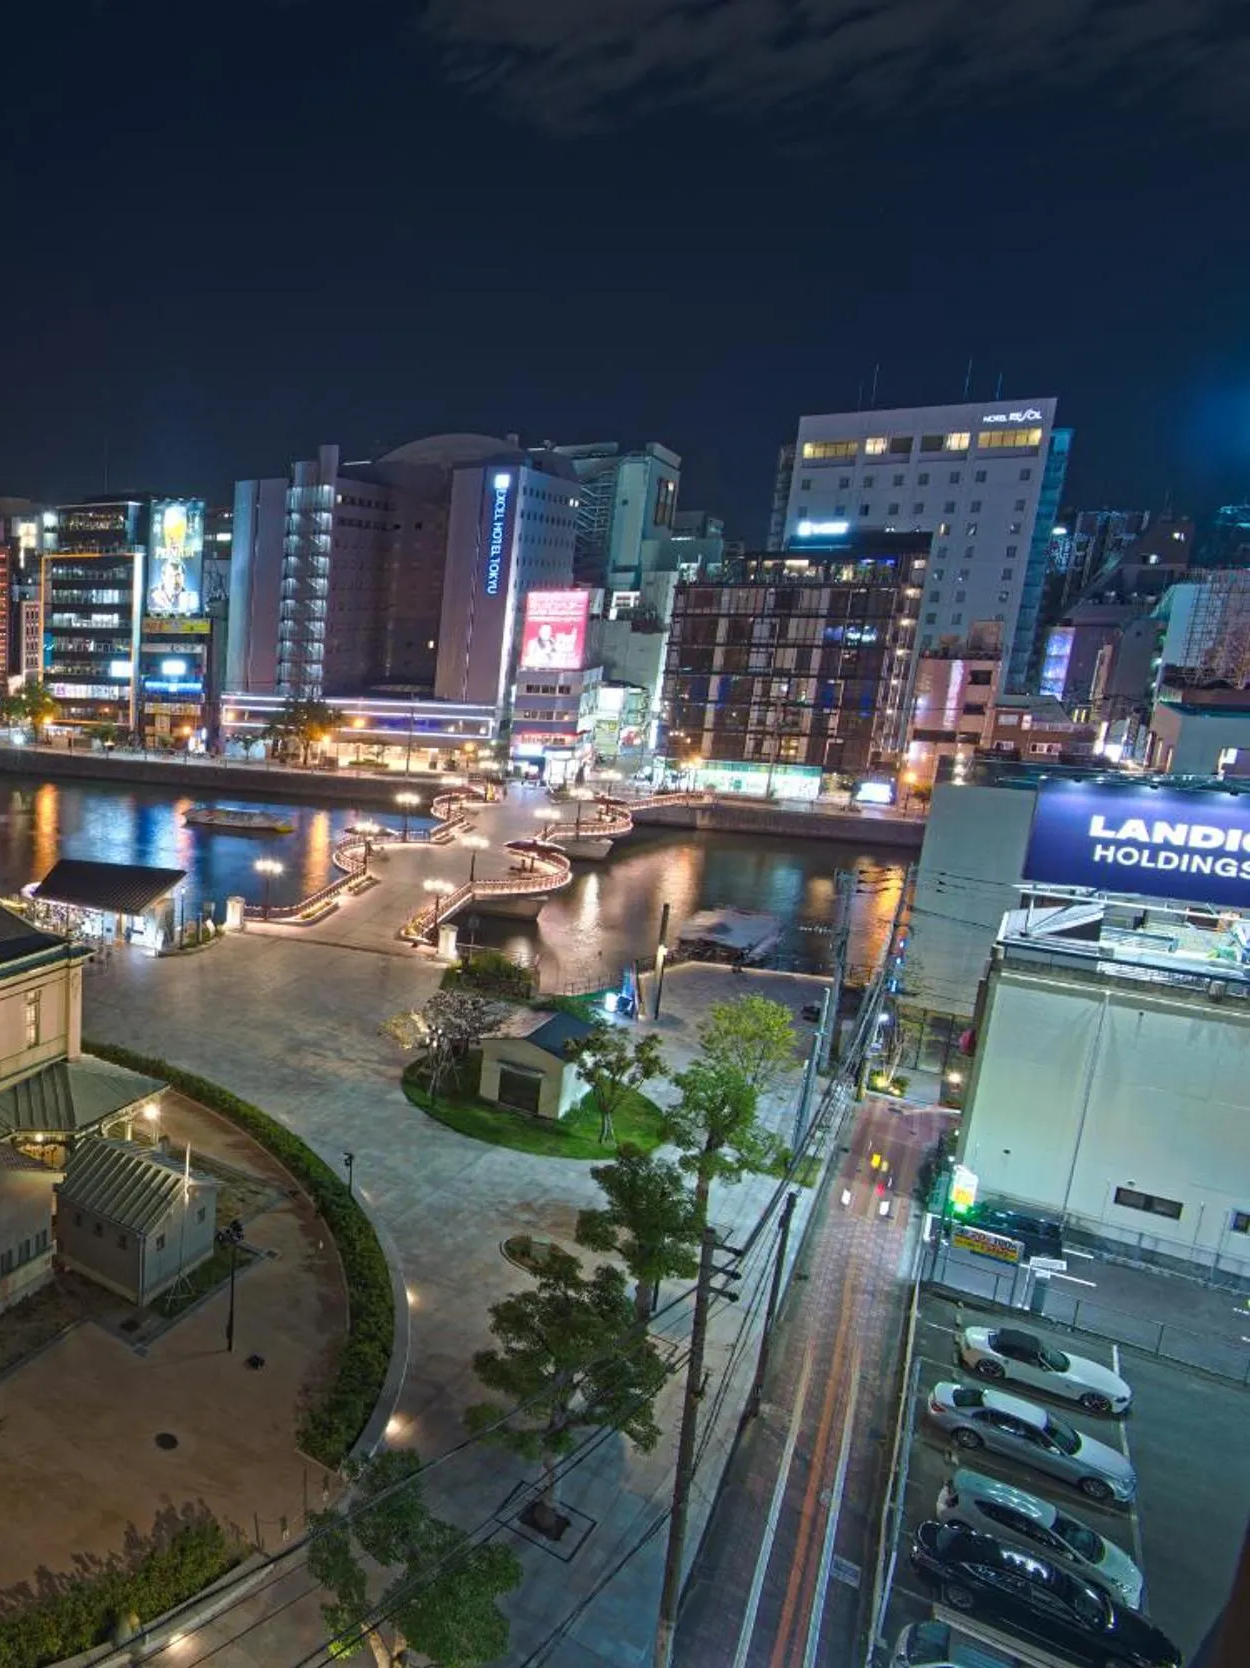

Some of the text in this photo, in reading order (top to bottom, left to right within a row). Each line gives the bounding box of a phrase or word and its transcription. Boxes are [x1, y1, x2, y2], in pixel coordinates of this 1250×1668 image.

[487, 487, 508, 595] EXCEL HOTEL TOKYU
[1088, 814, 1250, 853] LANDI
